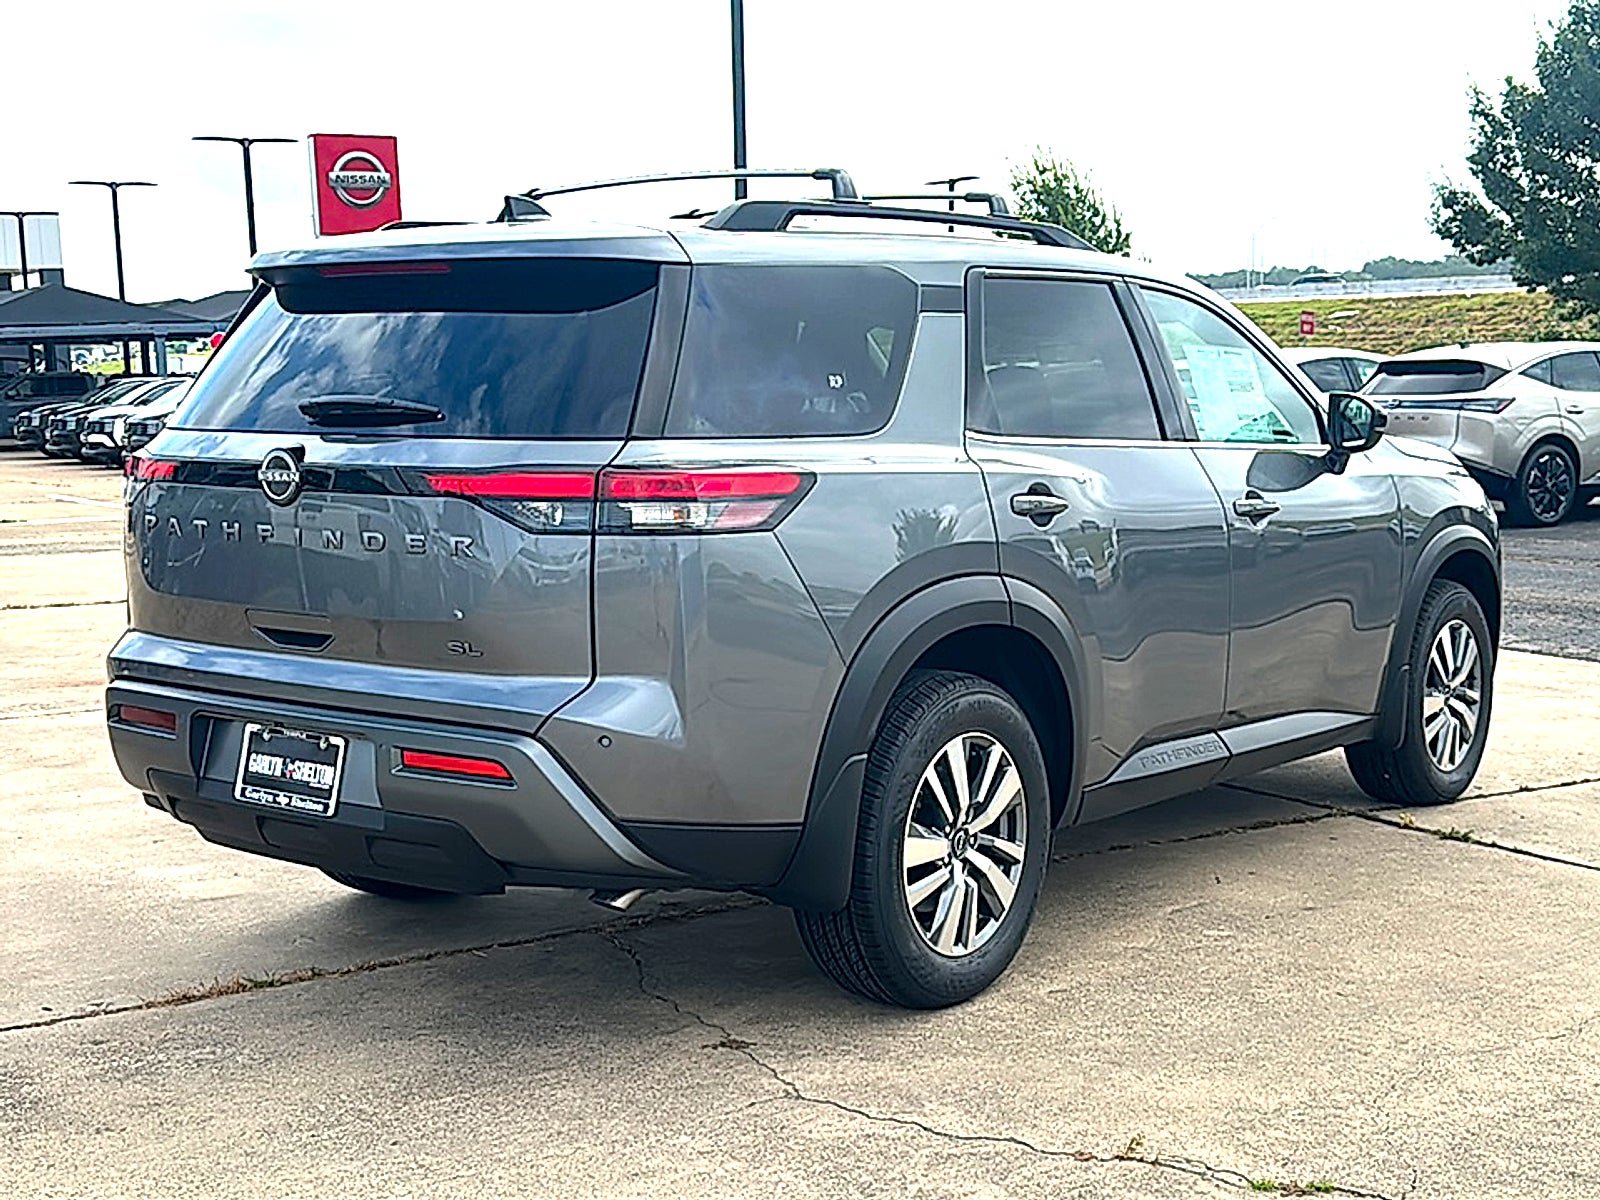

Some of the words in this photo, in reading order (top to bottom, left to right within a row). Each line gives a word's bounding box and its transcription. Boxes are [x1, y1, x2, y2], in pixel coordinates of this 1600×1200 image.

[334, 174, 386, 185] NISSAN
[144, 514, 476, 557] PATHFINDER
[447, 640, 483, 658] SL
[1140, 740, 1222, 768] PATHFINDER
